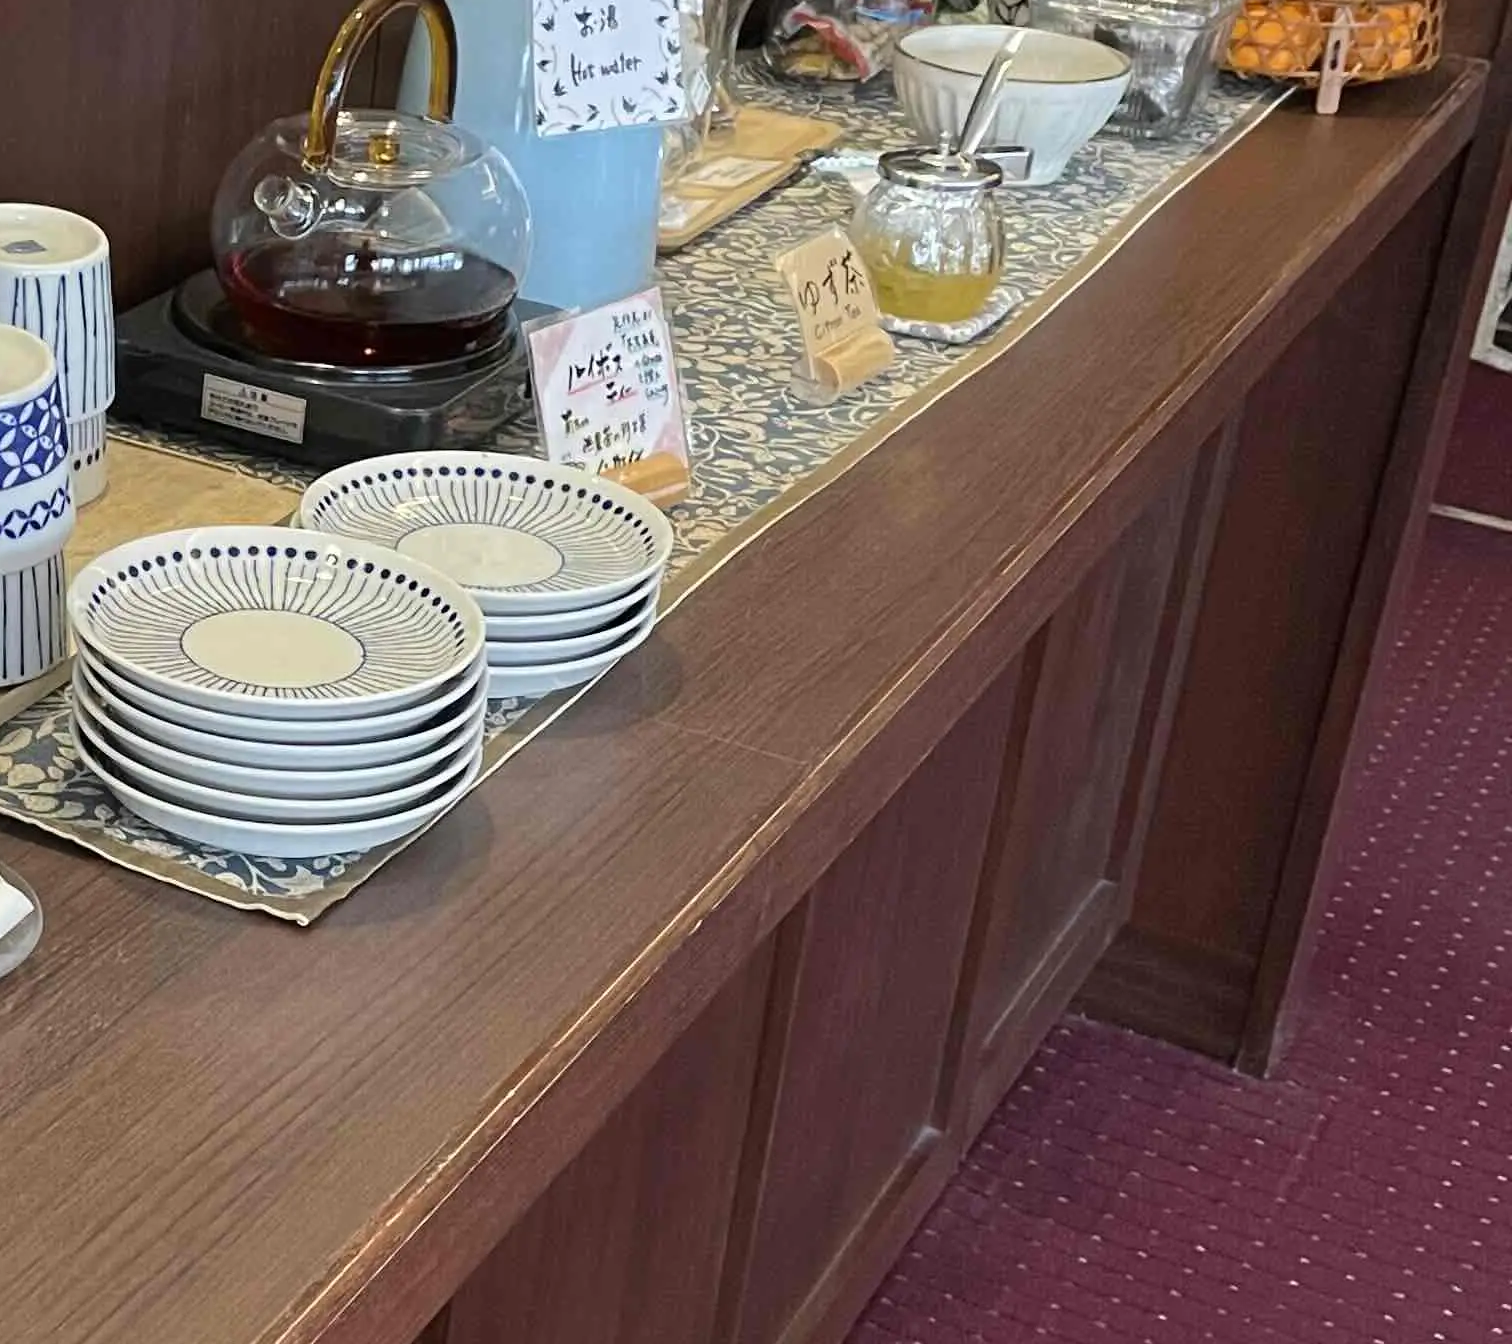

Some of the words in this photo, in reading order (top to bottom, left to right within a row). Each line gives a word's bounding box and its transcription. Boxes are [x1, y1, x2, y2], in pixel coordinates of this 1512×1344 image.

[574, 4, 619, 38] お湯
[570, 52, 595, 87] Hot
[600, 52, 643, 79] water
[798, 249, 866, 316] ゆず茶
